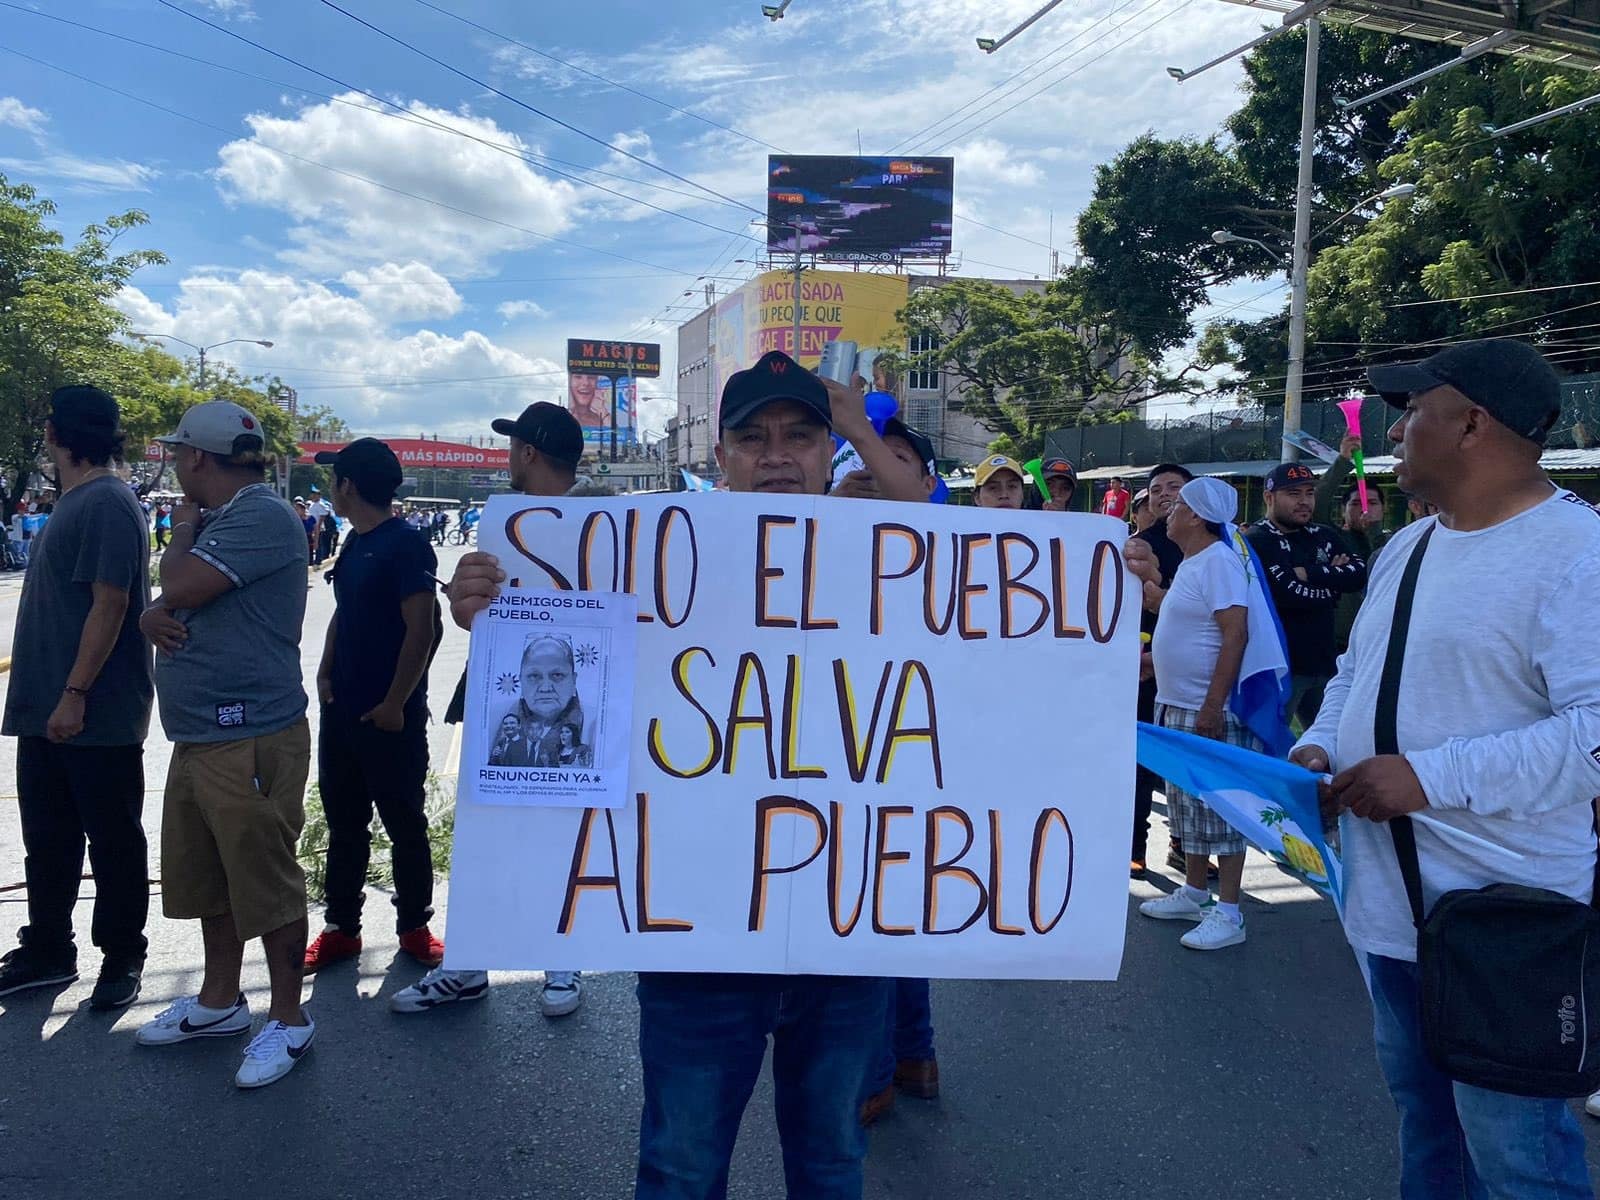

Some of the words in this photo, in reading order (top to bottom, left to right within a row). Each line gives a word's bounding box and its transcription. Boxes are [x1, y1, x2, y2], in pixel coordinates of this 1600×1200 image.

[815, 305, 842, 323] QUE
[402, 449, 433, 461] MÁS
[436, 449, 485, 463] RÁPIDO
[505, 505, 698, 629] SOLO
[755, 514, 839, 630] EL
[869, 522, 1124, 643] PUEBLO
[489, 595, 573, 609] ENEMIGOS
[576, 599, 605, 609] DEL
[488, 608, 554, 623] PUEBLO,
[647, 646, 944, 790] SALVA
[479, 768, 569, 783] RENUNCIEN
[572, 771, 591, 784] YA
[556, 791, 694, 936] AL
[747, 795, 1074, 937] PUEBLO
